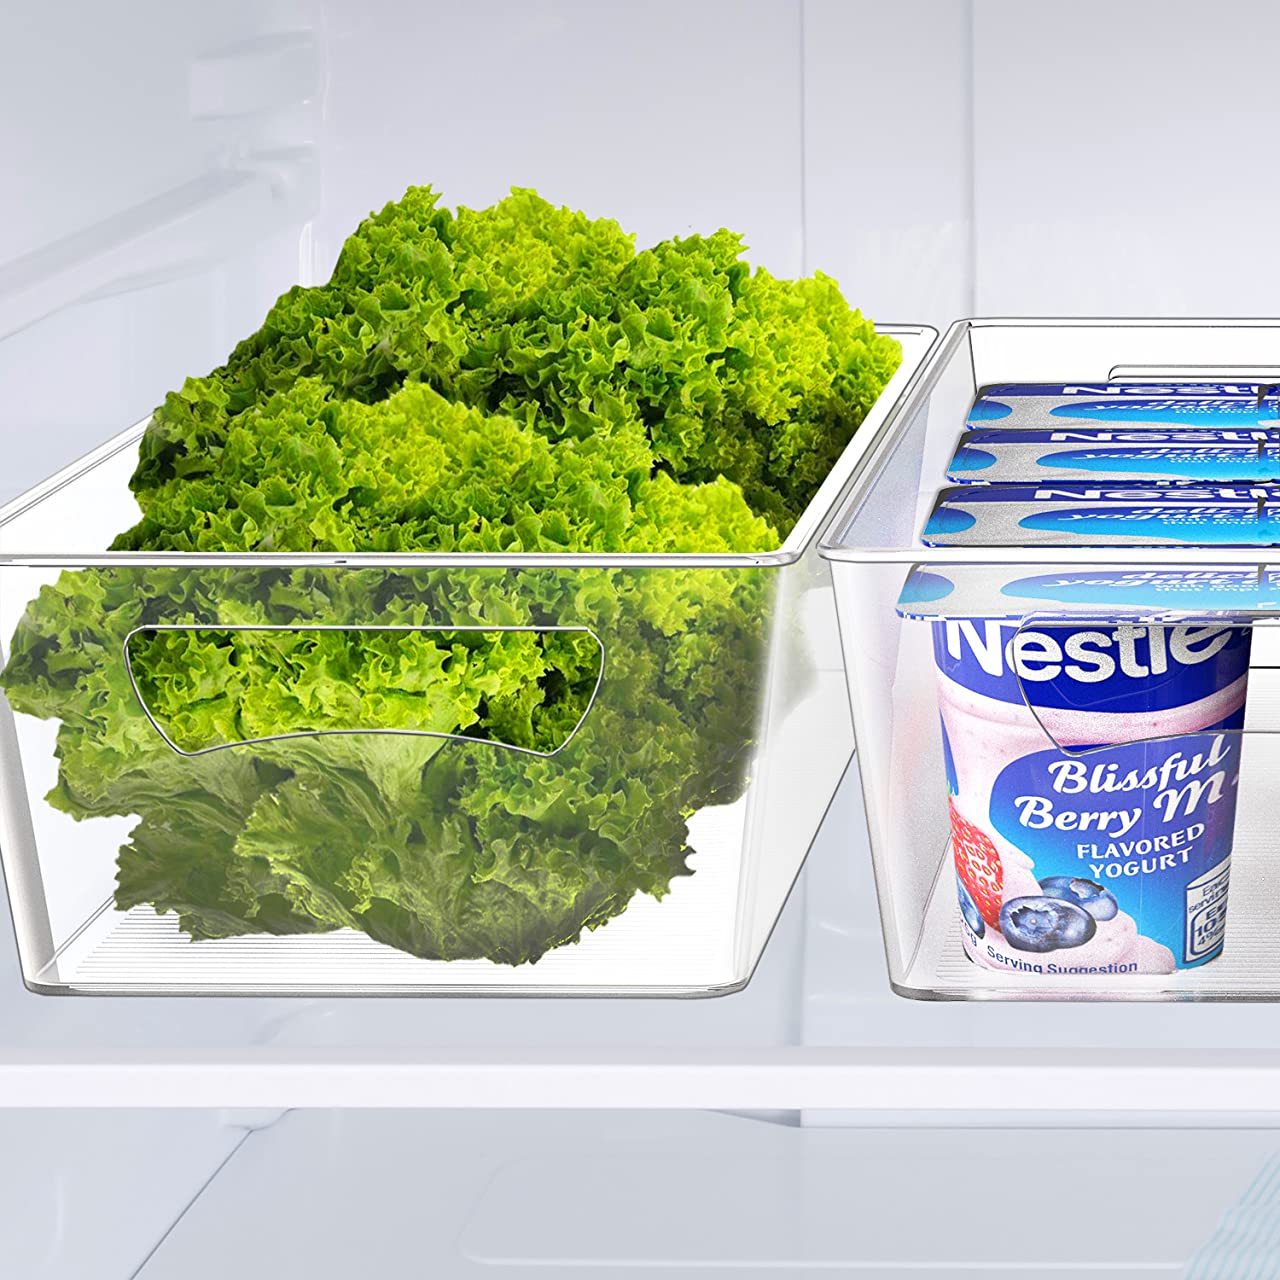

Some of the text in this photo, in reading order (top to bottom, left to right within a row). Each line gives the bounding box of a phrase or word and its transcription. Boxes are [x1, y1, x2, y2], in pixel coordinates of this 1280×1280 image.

[1048, 734, 1231, 793] Blissful
[1014, 796, 1142, 838] Berry
[1077, 823, 1205, 859] FLAVORED
[1089, 846, 1193, 879] YOGURT
[987, 944, 1043, 973] Serving
